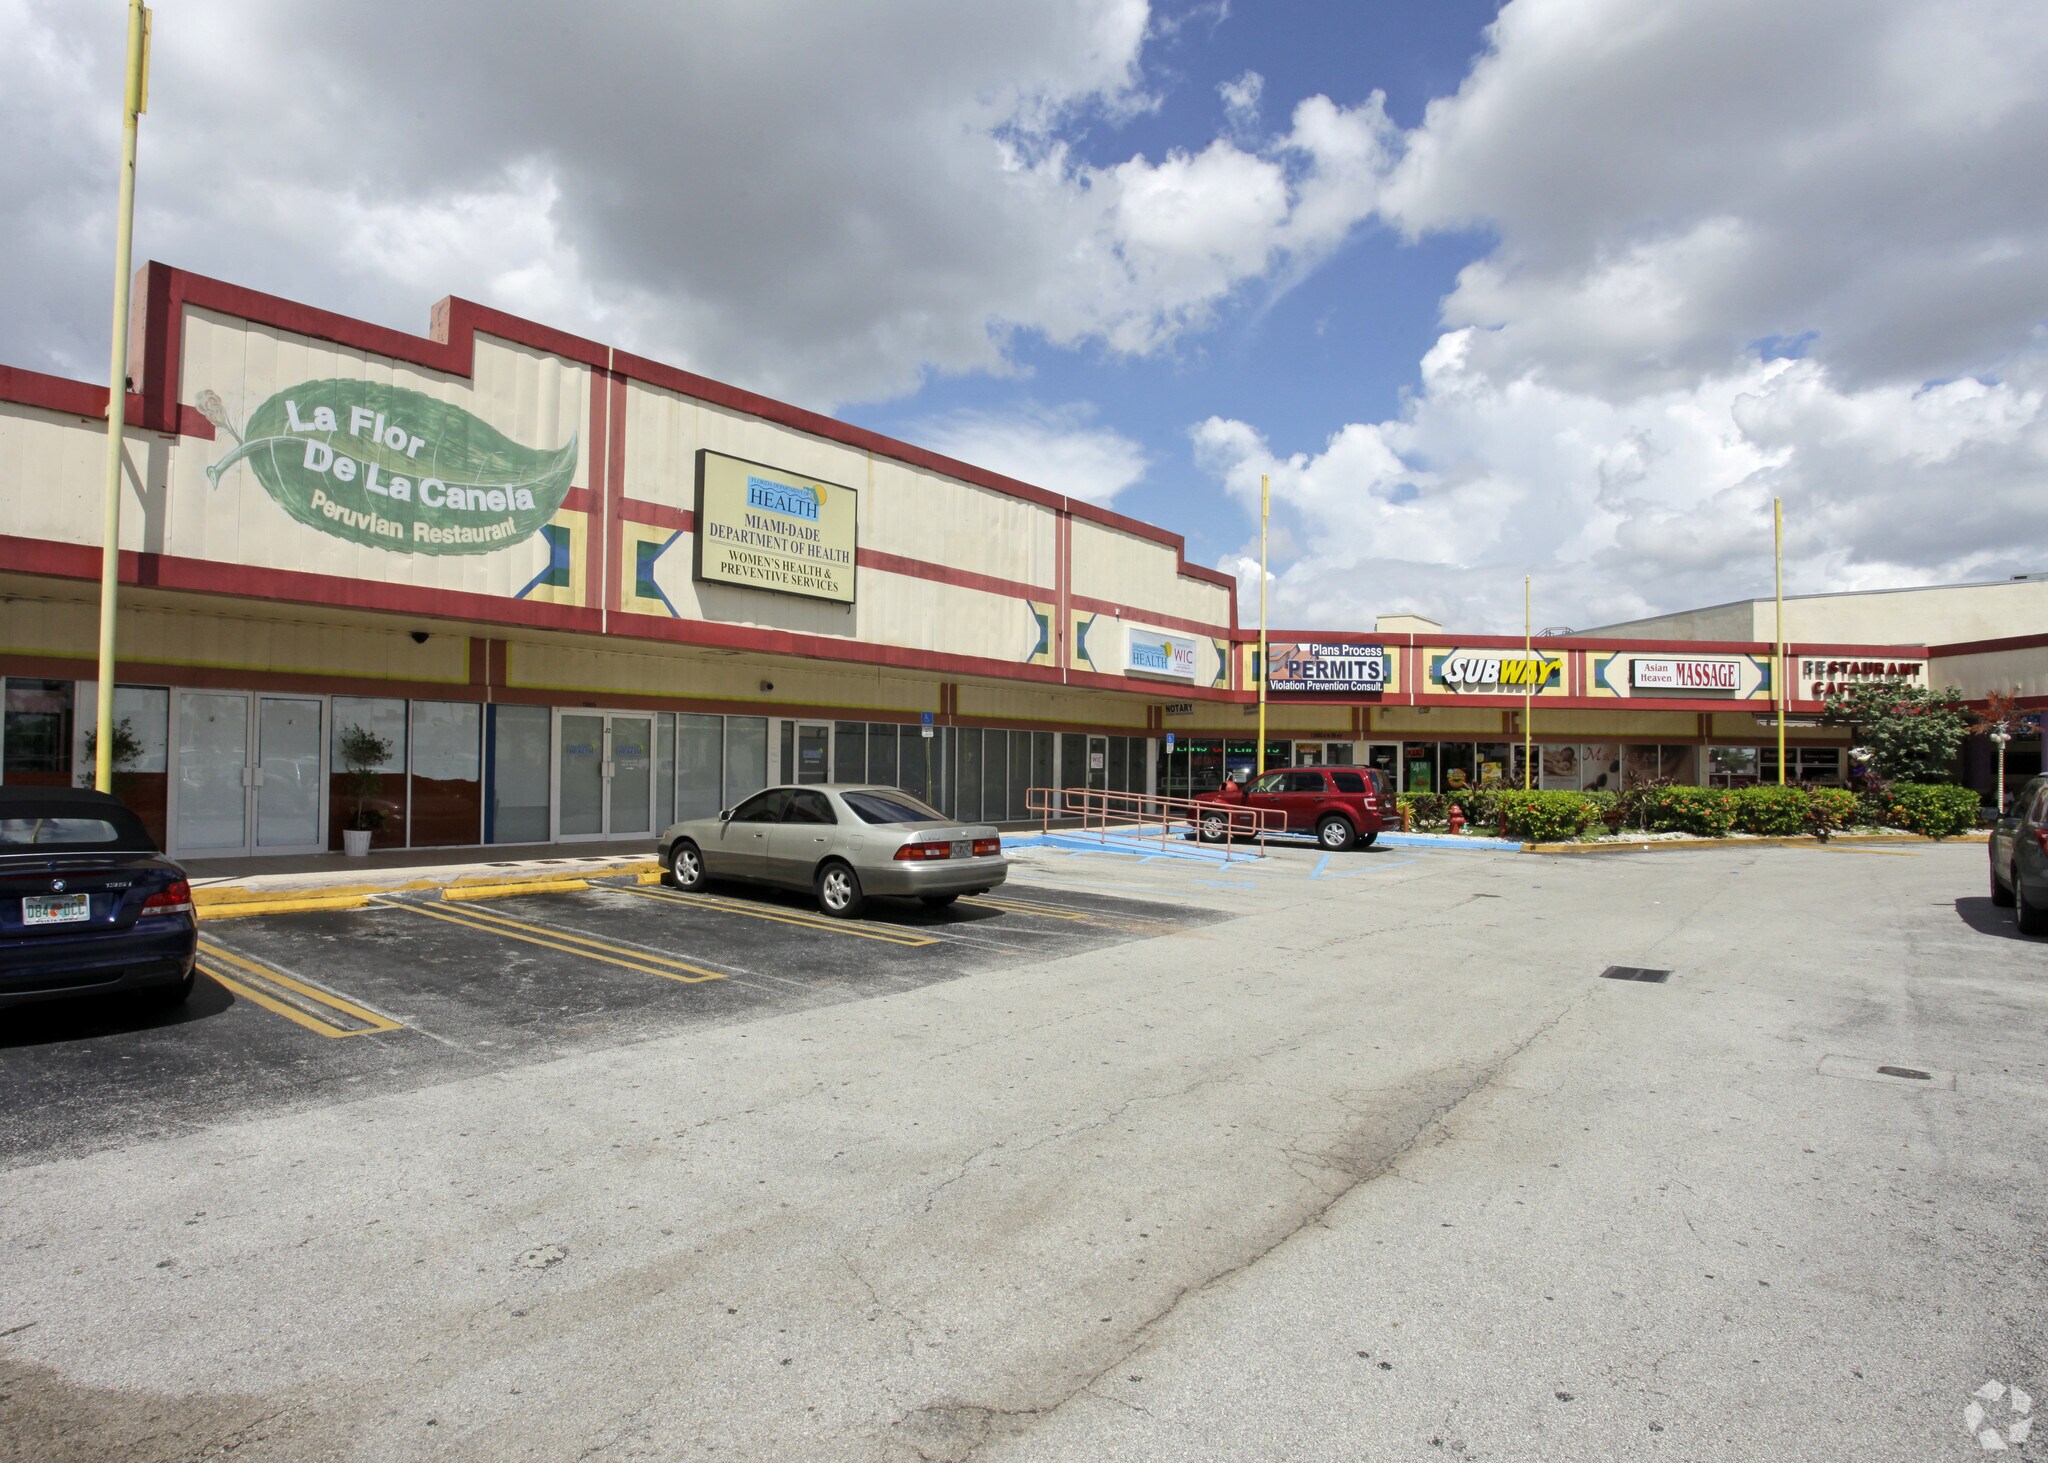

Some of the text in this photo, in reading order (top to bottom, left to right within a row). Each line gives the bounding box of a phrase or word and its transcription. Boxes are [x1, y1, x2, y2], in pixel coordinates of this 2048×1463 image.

[285, 400, 425, 458] La Flor
[303, 439, 536, 513] De La Canela
[750, 488, 817, 518] HEALTH
[311, 488, 517, 545] Peruvian Restaurant
[745, 513, 820, 542] MIAMI-DADE
[710, 523, 849, 563] DEPARTMENT OF HEALTH
[720, 562, 839, 592] PREVENTIVE SERVICES
[729, 550, 832, 579] WOMEN'S HEALTH &
[1132, 651, 1168, 669] HEALTH
[1174, 648, 1193, 664] WIC
[1312, 644, 1383, 657] Plans Process
[1288, 660, 1381, 679] PERMITS
[1444, 658, 1563, 684] SUBWAY
[1641, 673, 1672, 682] Heaven
[1644, 663, 1668, 672] Asian
[1676, 662, 1736, 687] MASSAGE
[1802, 660, 1923, 677] RESTAURANT
[1270, 680, 1383, 691] Violation Prevention Consult.
[1165, 703, 1193, 714] NOTARY
